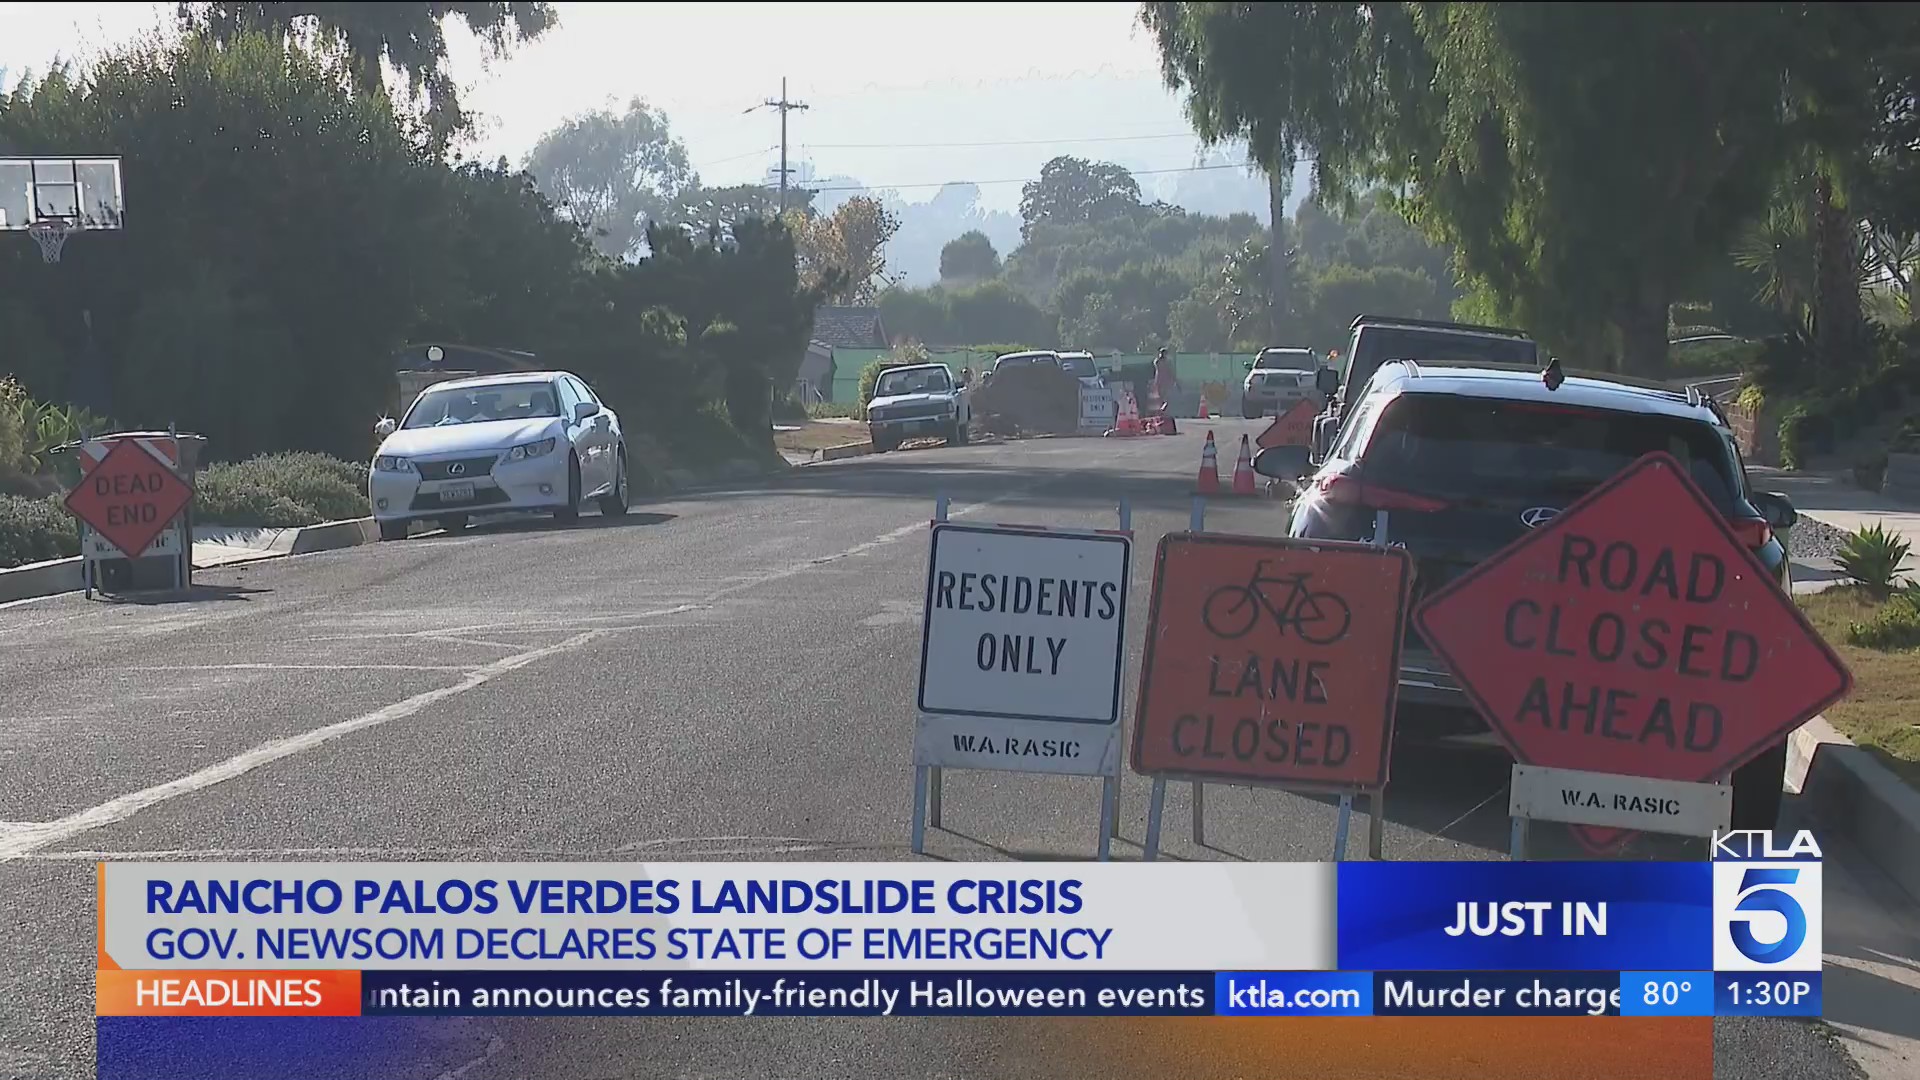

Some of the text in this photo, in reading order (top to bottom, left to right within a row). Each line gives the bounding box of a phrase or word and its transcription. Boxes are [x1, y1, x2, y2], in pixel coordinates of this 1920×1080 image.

[95, 472, 163, 496] DEAD
[107, 503, 157, 526] END
[1557, 533, 1726, 604] ROAD
[936, 571, 1117, 620] RESIDENTS
[977, 633, 1068, 676] ONLY
[1504, 599, 1760, 683] CLOSED
[1208, 655, 1331, 704] LANE
[1514, 676, 1724, 753] AHEAD
[1172, 714, 1352, 769] CLOSED
[1613, 793, 1681, 816] RASIC
